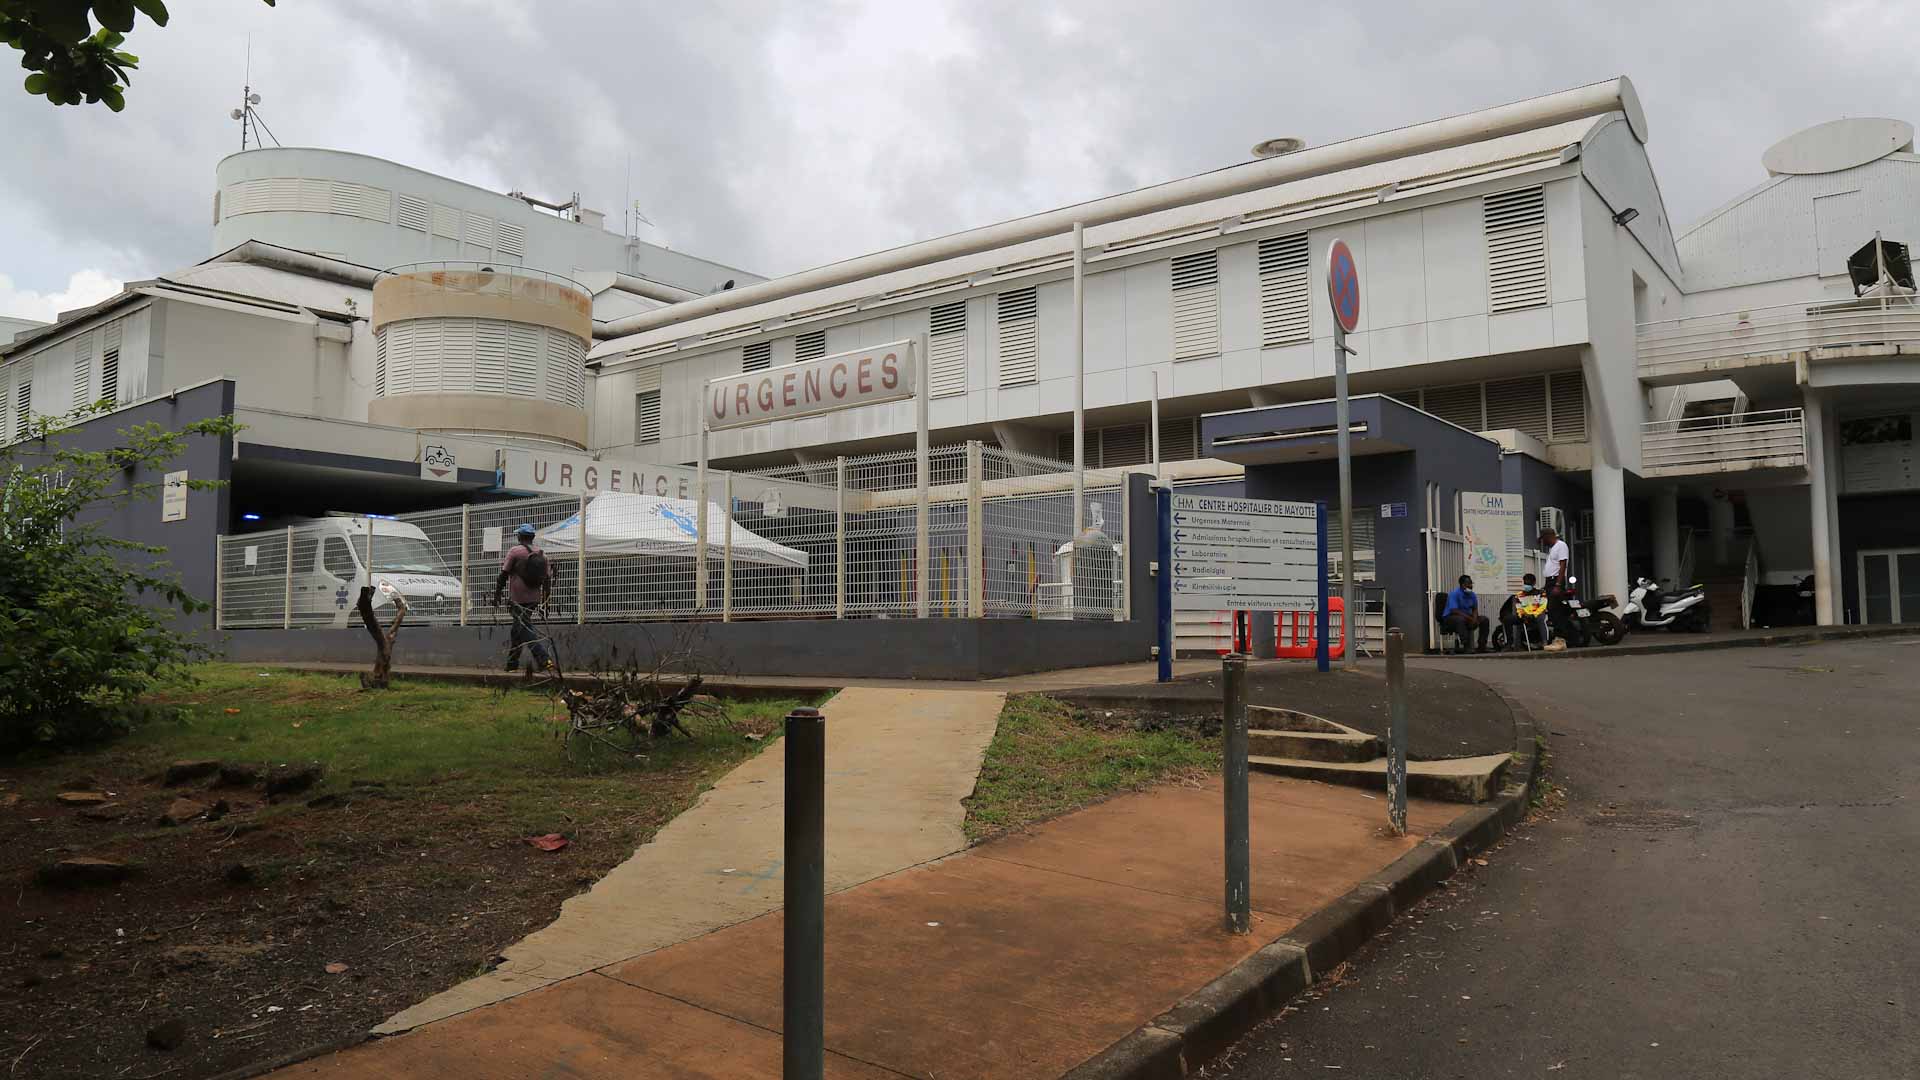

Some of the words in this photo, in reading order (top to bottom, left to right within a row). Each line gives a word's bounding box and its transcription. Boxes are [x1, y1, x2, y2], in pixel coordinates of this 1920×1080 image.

[713, 353, 898, 420] URGENCES
[1172, 494, 1194, 509] CHM
[1199, 499, 1226, 511] CENTRE
[1227, 500, 1272, 514] HOSPITALIER
[1274, 504, 1283, 514] DE
[1284, 504, 1316, 516] MAYOTTE
[1481, 494, 1504, 508] CHM
[1191, 534, 1227, 542] Admissions
[1191, 550, 1228, 558] Laboratoire
[1192, 566, 1226, 576] Radiologie
